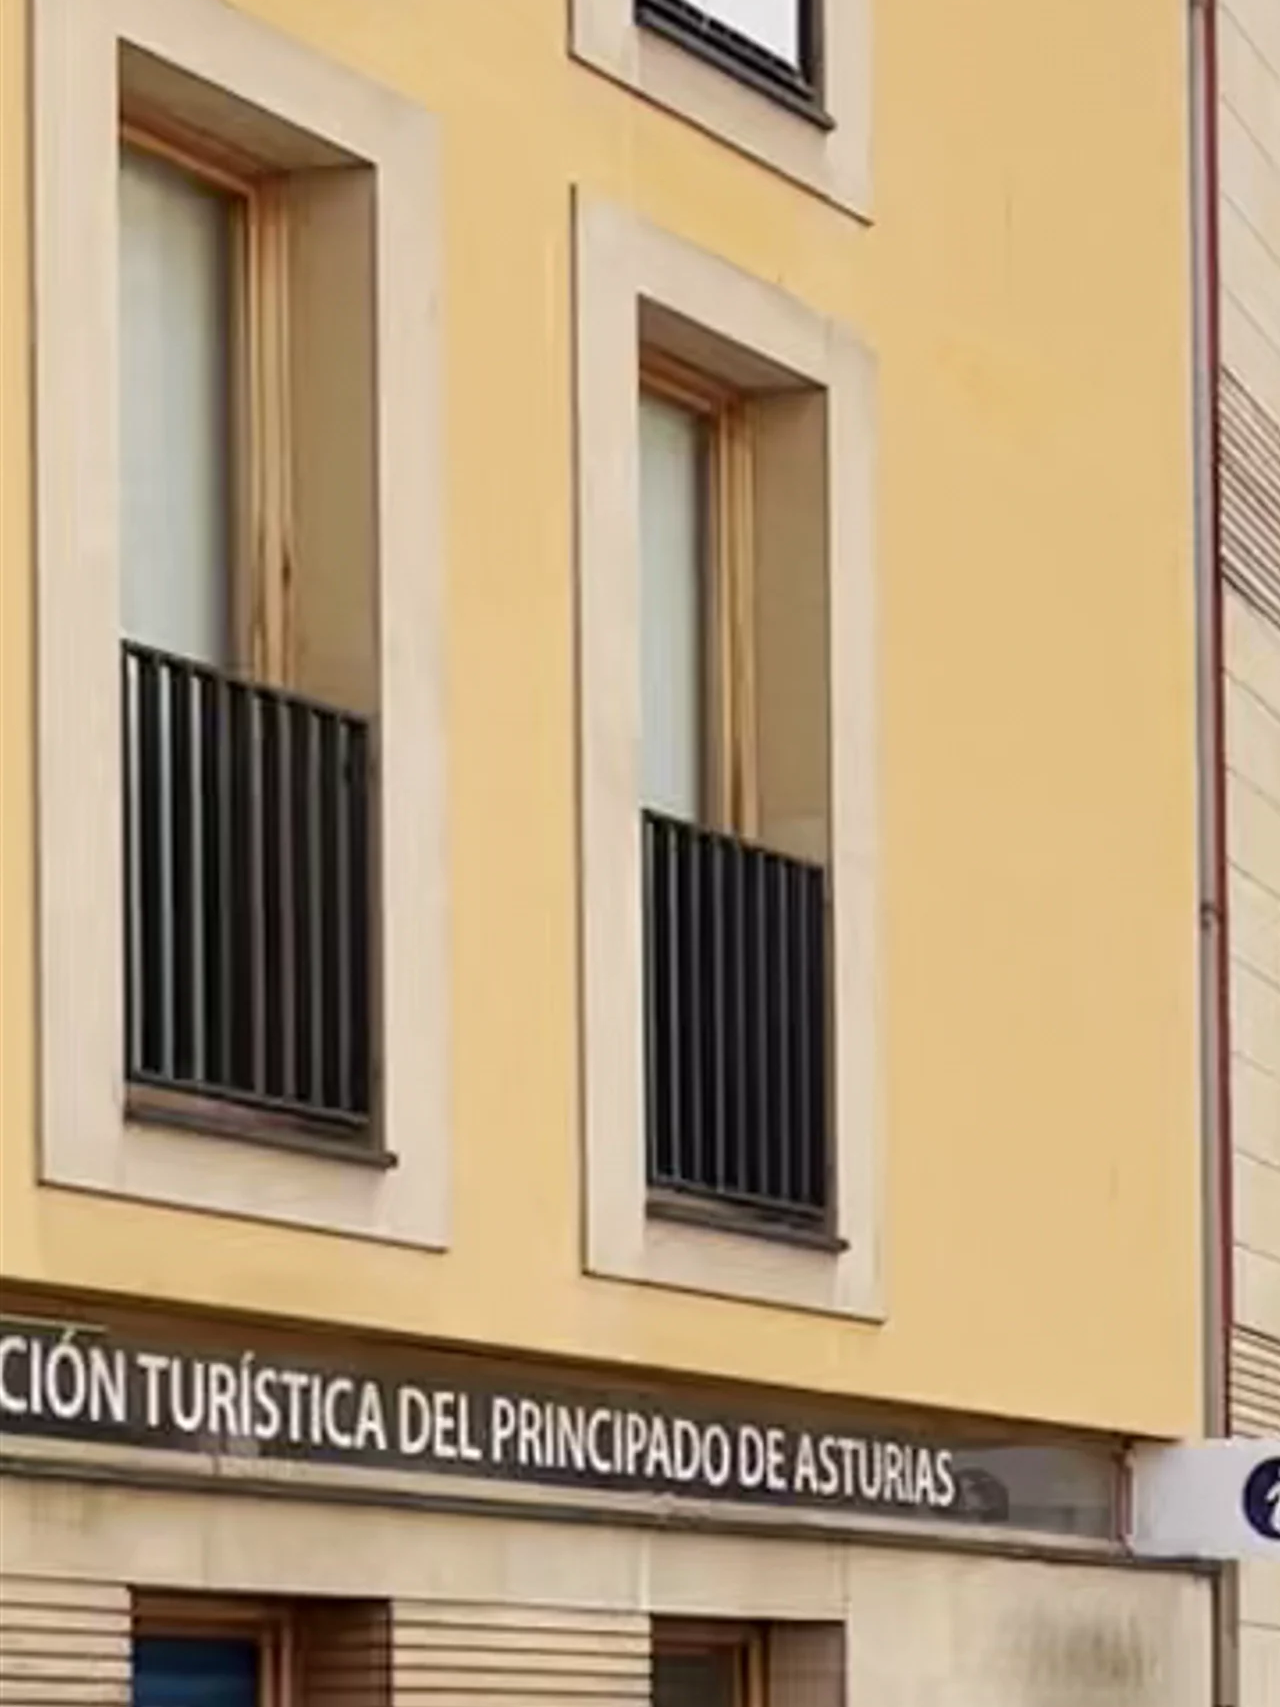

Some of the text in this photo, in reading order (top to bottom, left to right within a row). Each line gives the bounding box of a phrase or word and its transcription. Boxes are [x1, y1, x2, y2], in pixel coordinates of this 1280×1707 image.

[0, 1327, 957, 1507] CIÓN TURÍSTICA DEL PRINCIPADO DE ASTURIAS
